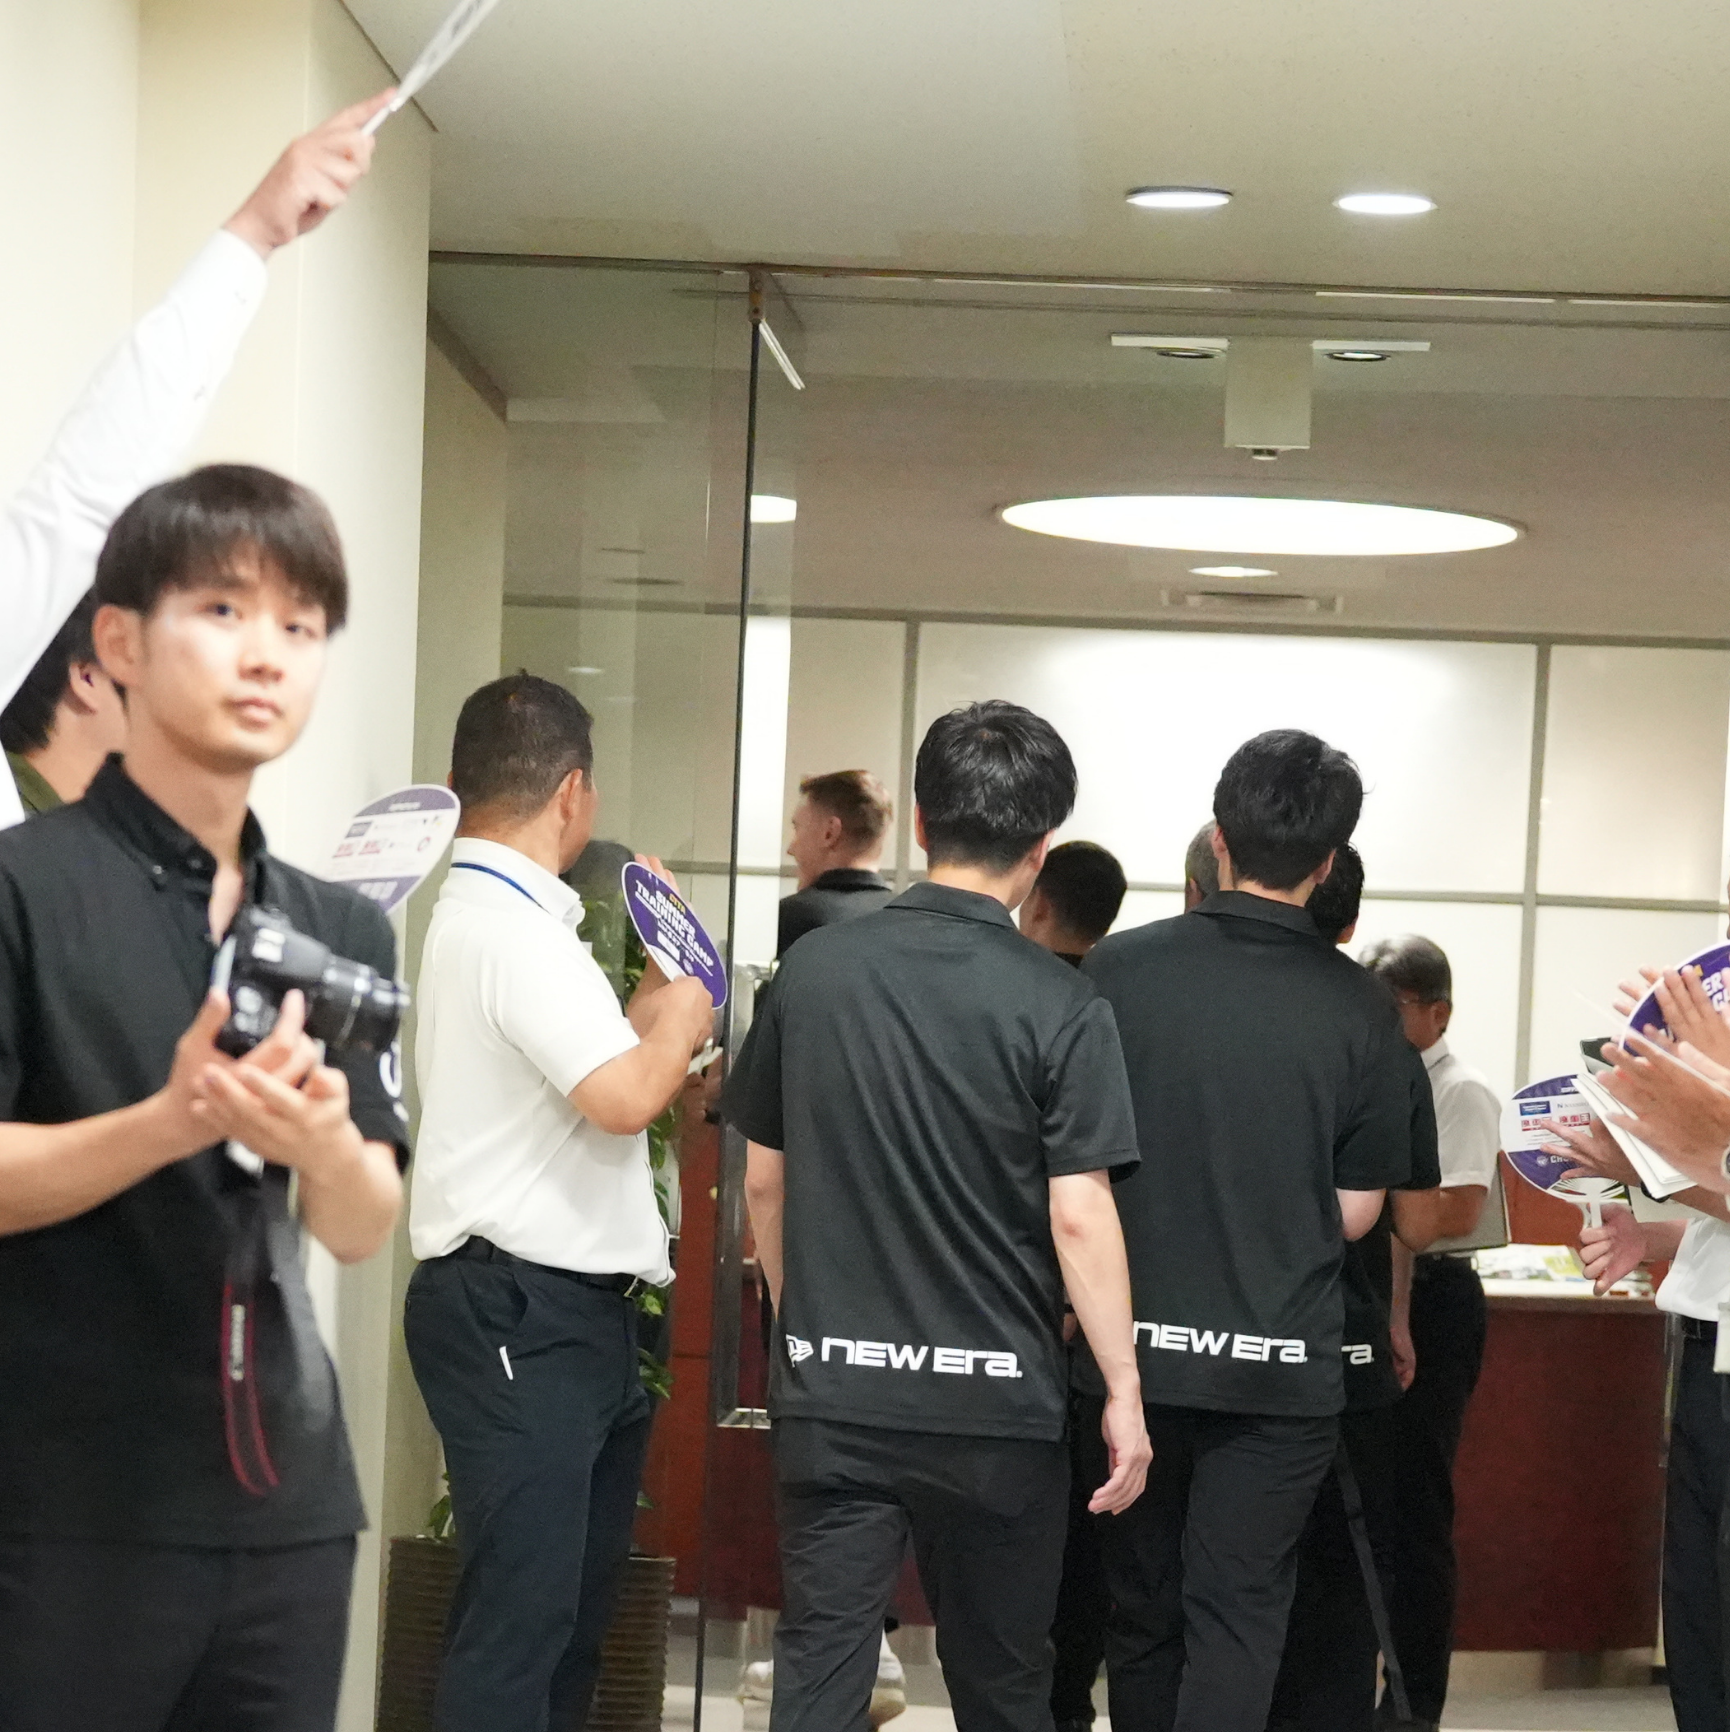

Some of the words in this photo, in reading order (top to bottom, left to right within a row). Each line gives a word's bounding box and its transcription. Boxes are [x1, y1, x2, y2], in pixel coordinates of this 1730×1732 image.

[635, 880, 686, 937] TRAINING
[687, 934, 714, 967] CAMP
[656, 890, 696, 940] SUMMER
